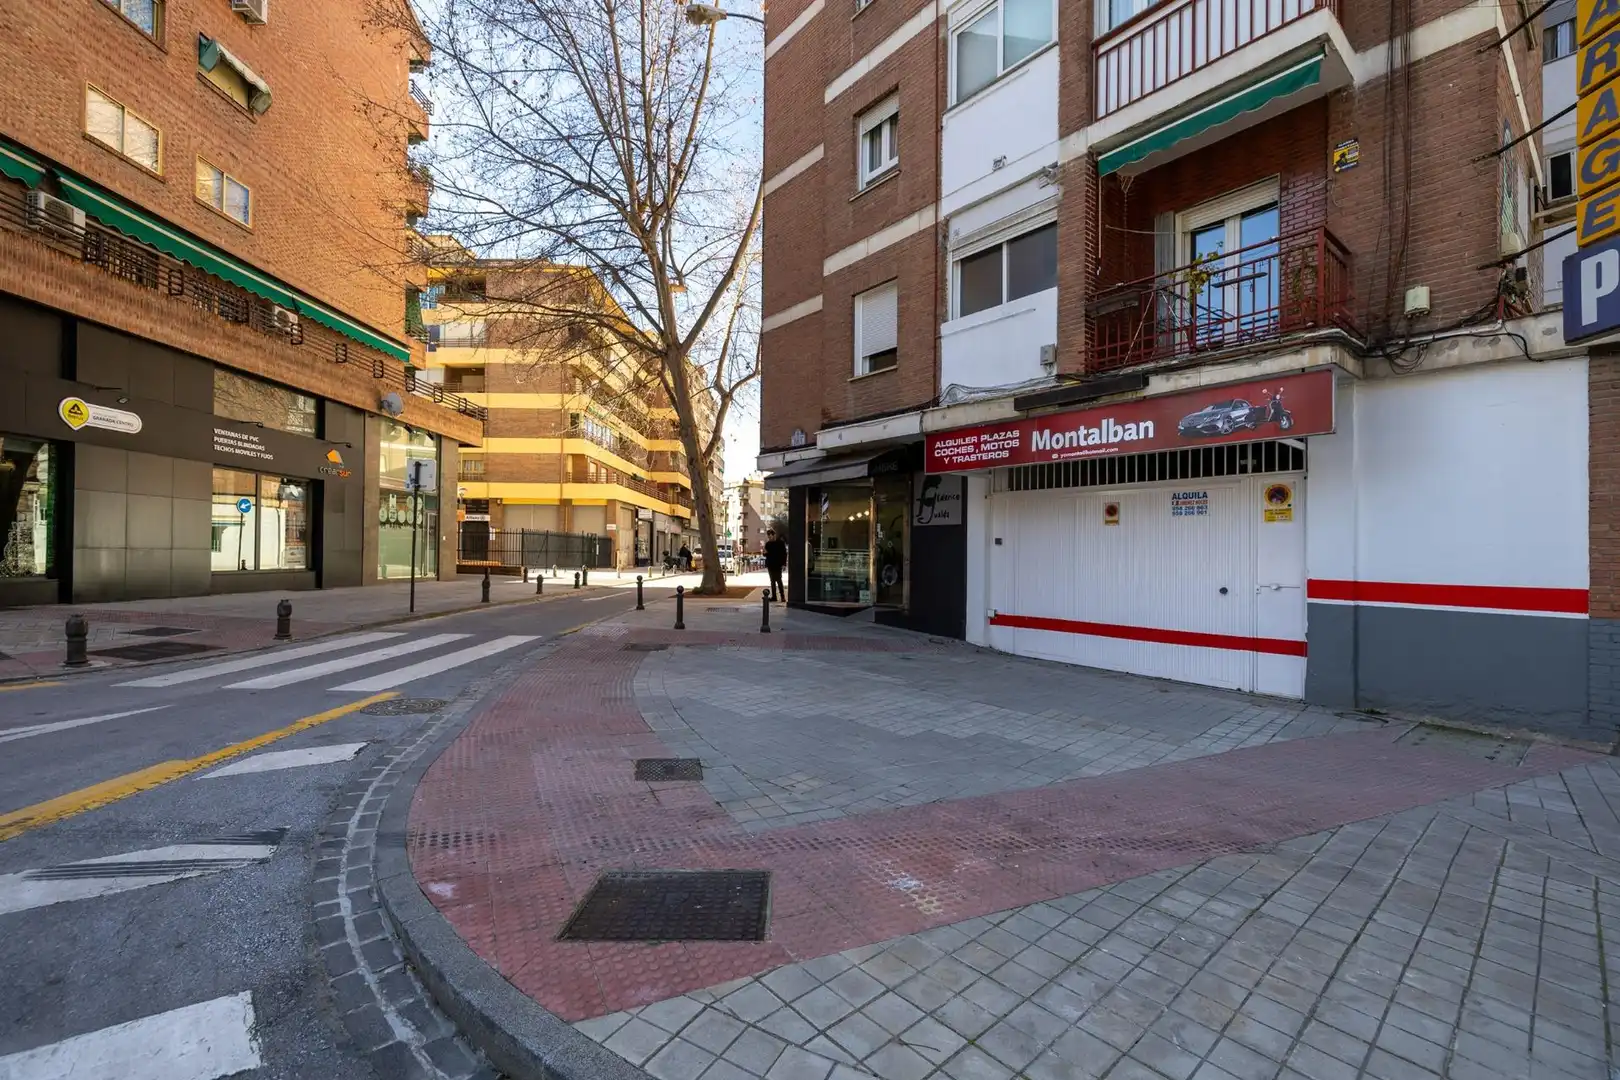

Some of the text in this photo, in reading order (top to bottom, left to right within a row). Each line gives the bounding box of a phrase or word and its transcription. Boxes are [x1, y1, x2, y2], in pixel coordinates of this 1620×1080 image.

[1580, 249, 1620, 327] P
[213, 428, 241, 439] VENTANAS
[935, 430, 1020, 449] ALQUILER PLAZAS
[1031, 418, 1154, 452] Montalban
[213, 436, 265, 451] PUERTAS BLINDADAS
[980, 439, 1020, 451] MOTOS
[213, 444, 235, 453] TECHOS
[235, 448, 257, 458] MOVILES
[260, 452, 274, 460] FIJOS
[943, 450, 1010, 465] Y TRASTEROS
[1172, 491, 1208, 501] ALQUILA
